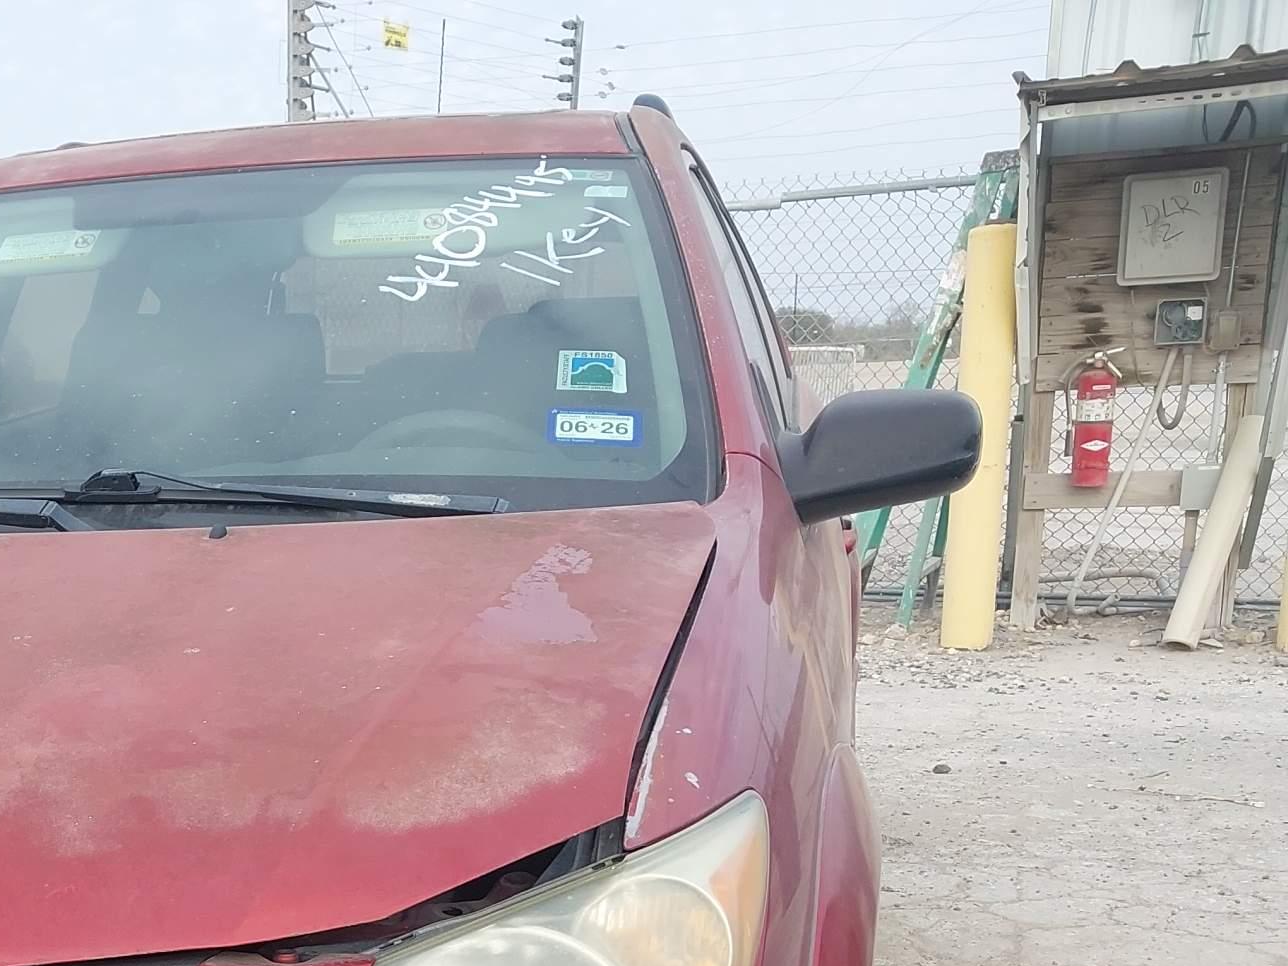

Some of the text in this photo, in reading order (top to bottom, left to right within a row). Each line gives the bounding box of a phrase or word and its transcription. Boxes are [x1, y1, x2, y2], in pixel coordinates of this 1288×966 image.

[1193, 180, 1210, 194] 05
[1141, 195, 1201, 227] DLR
[379, 155, 573, 302] 44084445
[560, 420, 629, 435] 06 26
